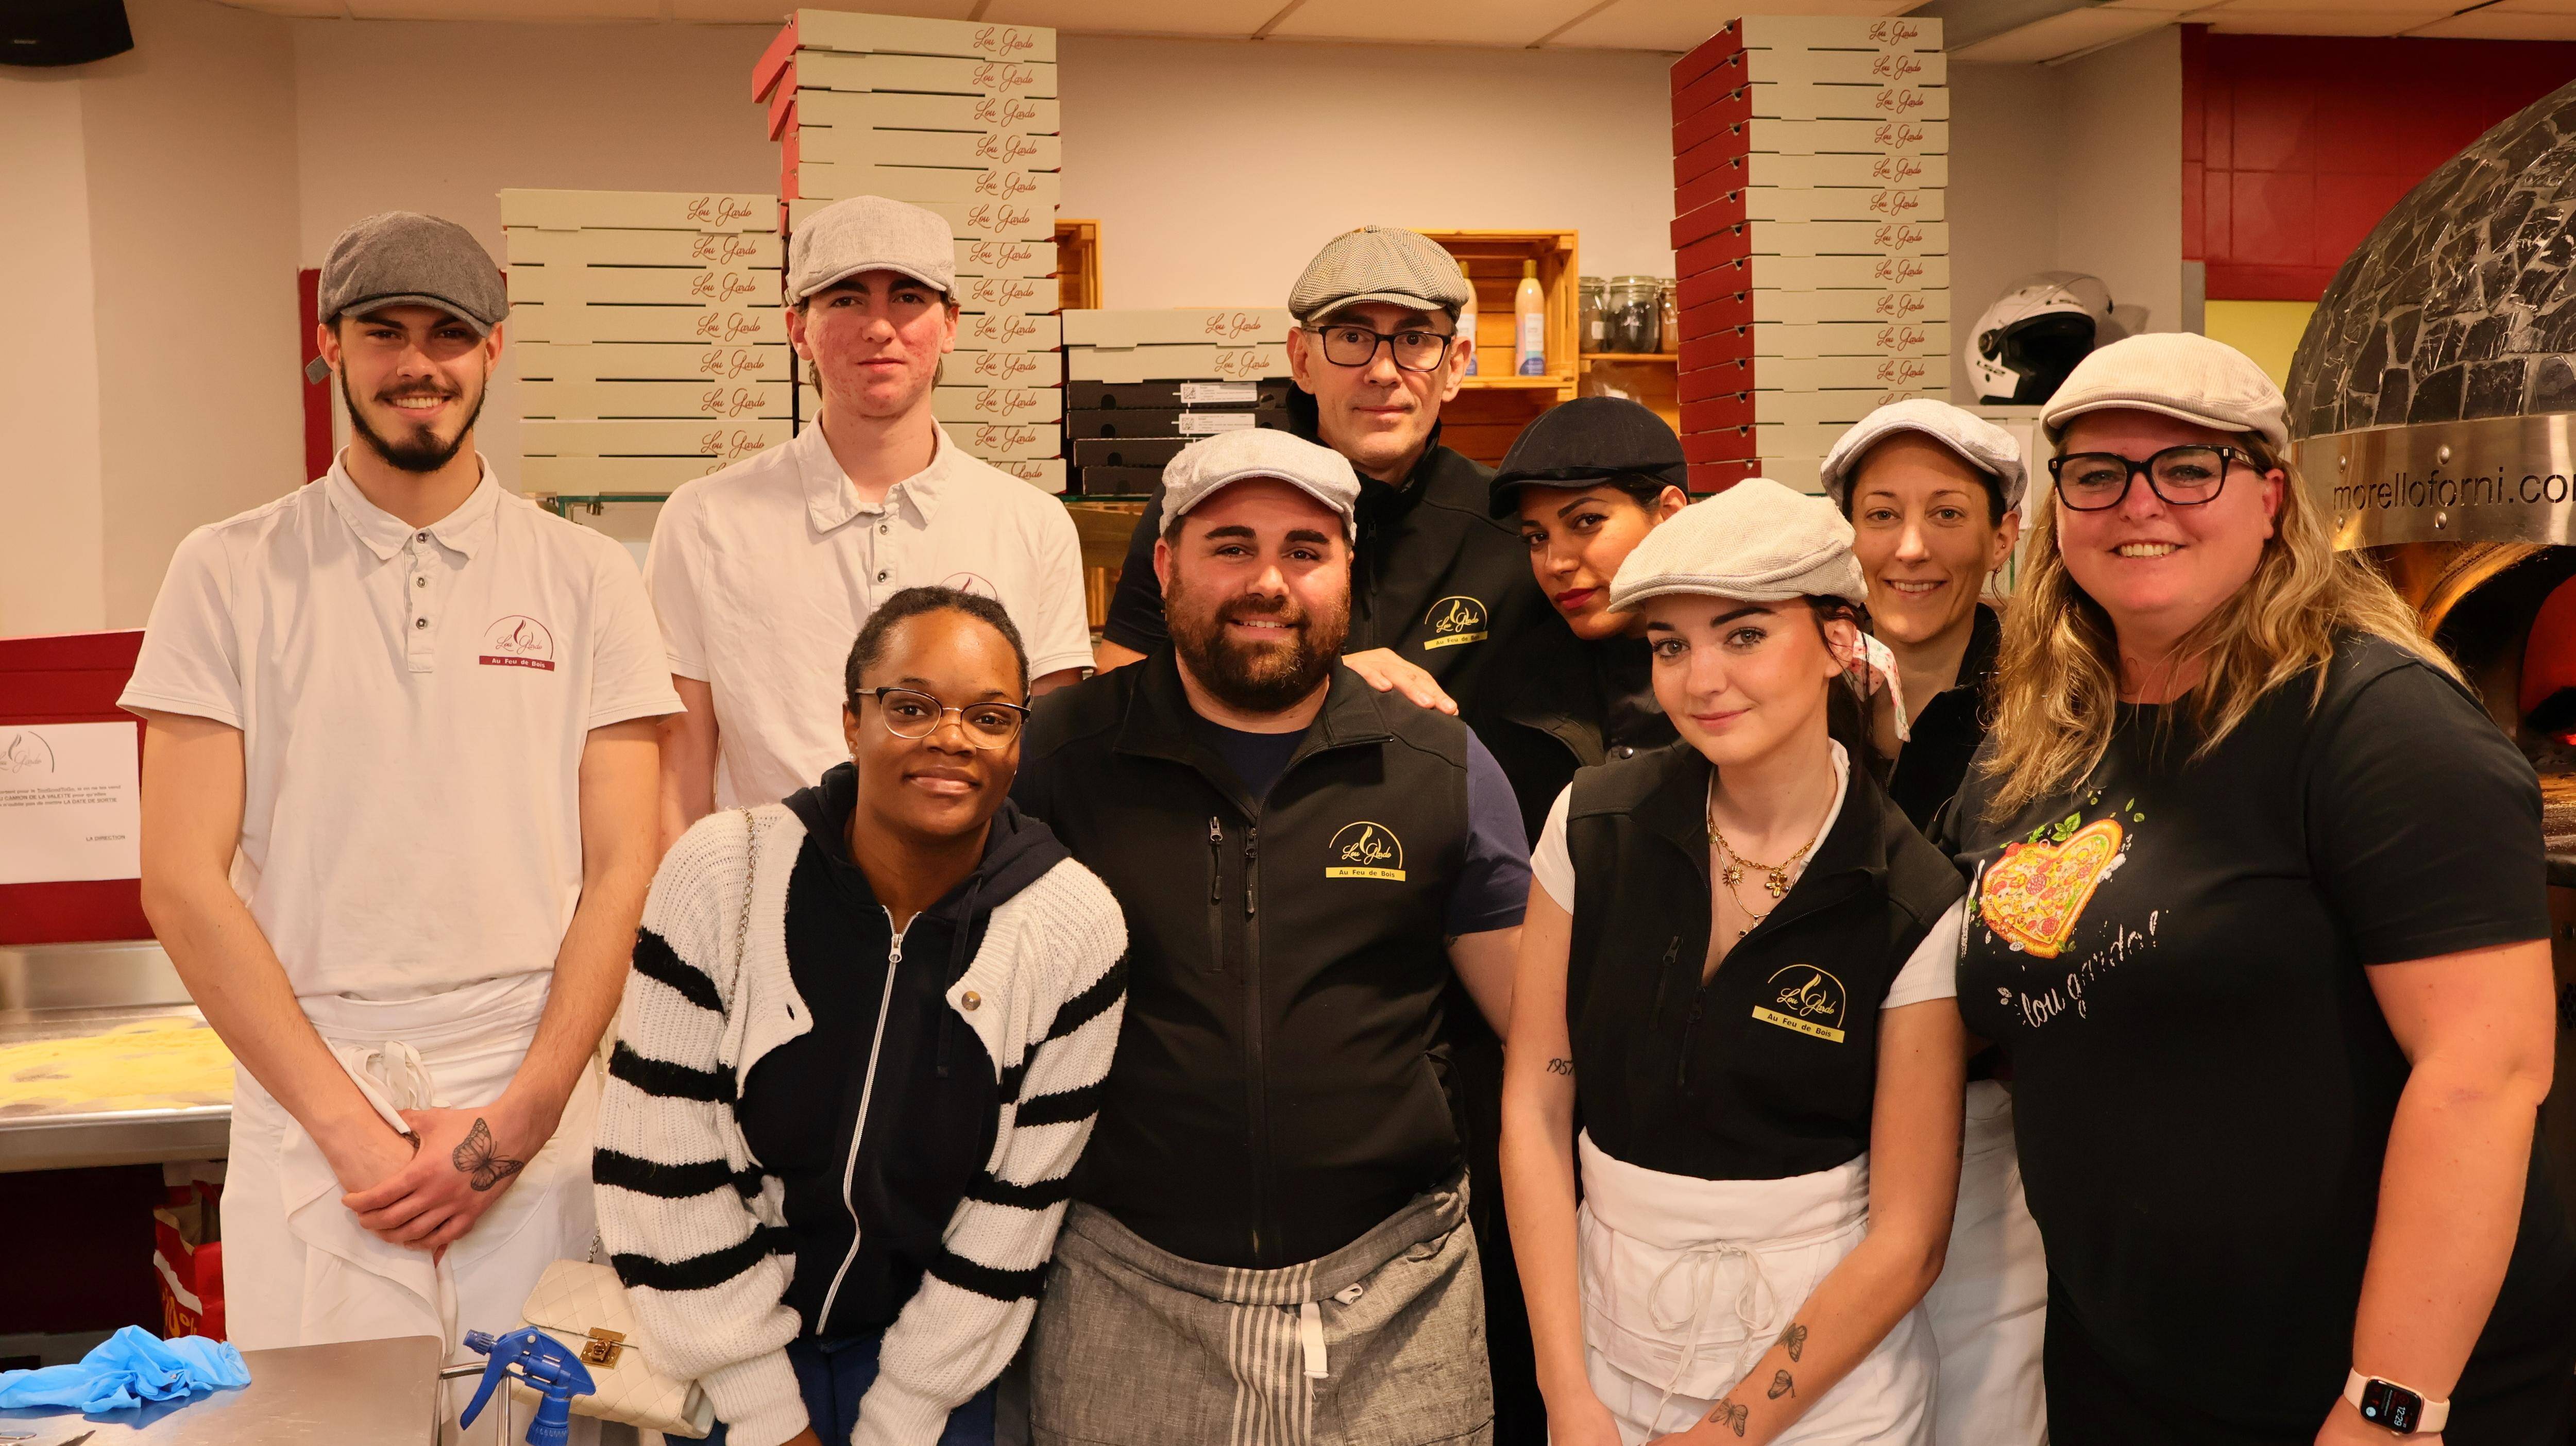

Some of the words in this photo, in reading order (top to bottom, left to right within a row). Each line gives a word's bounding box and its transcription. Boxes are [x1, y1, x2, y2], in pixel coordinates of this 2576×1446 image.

[973, 27, 996, 52] Lou
[999, 28, 1034, 56] Gardo
[1869, 21, 1888, 42] Lou
[973, 63, 996, 88] Lou
[999, 64, 1033, 92] Gardo
[1873, 55, 1892, 76] Lou
[974, 98, 997, 123] Lou
[1001, 99, 1035, 127] Gardo
[1875, 90, 1894, 110] Lou
[1874, 124, 1893, 145] Lou
[976, 134, 999, 159] Lou
[1003, 135, 1037, 163] Gardo
[1873, 158, 1892, 179] Lou
[975, 171, 998, 195] Lou
[1002, 172, 1036, 200] Gardo
[687, 197, 712, 222] Lou
[716, 197, 751, 226] Gardo
[1870, 192, 1889, 212] Lou
[969, 204, 992, 228] Lou
[995, 205, 1029, 233] Gardo
[692, 235, 717, 260] Lou
[721, 235, 756, 264] Gardo
[1874, 226, 1893, 246] Lou
[970, 242, 993, 264] Lou
[996, 242, 1031, 269] Gardo
[1874, 259, 1893, 280] Lou
[691, 273, 716, 298] Lou
[720, 273, 755, 302] Gardo
[972, 279, 995, 302] Lou
[998, 279, 1033, 307] Gardo
[1876, 294, 1895, 314] Lou
[697, 312, 721, 338] Lou
[725, 312, 760, 342] Gardo
[975, 314, 998, 339] Lou
[1001, 315, 1036, 344] Gardo
[1206, 313, 1227, 335] Lou
[1229, 313, 1261, 339] Gardo
[1876, 327, 1895, 347] Lou
[700, 349, 725, 375] Lou
[728, 349, 764, 379] Gardo
[975, 354, 998, 376] Lou
[1002, 354, 1036, 380] Gardo
[1214, 351, 1235, 374] Lou
[1239, 351, 1269, 378] Gardo
[1876, 360, 1895, 381] Lou
[701, 388, 726, 413] Lou
[730, 388, 765, 417] Gardo
[975, 390, 998, 412] Lou
[1002, 390, 1036, 417] Gardo
[701, 430, 725, 455] Lou
[729, 430, 765, 458] Gardo
[975, 426, 998, 448] Lou
[1001, 426, 1036, 453] Gardo
[2333, 467, 2576, 511] morelloforni.co
[1436, 616, 1453, 633] Lou
[496, 634, 515, 651] Lou
[1342, 842, 1362, 861] Lou
[1776, 988, 1801, 1010] Lou
[2021, 988, 2065, 1028] lou
[1768, 1013, 1778, 1021] Au
[1783, 1018, 1797, 1028] Feu
[1816, 1028, 1832, 1037] Bois
[2394, 1406, 2405, 1426] 12:29
